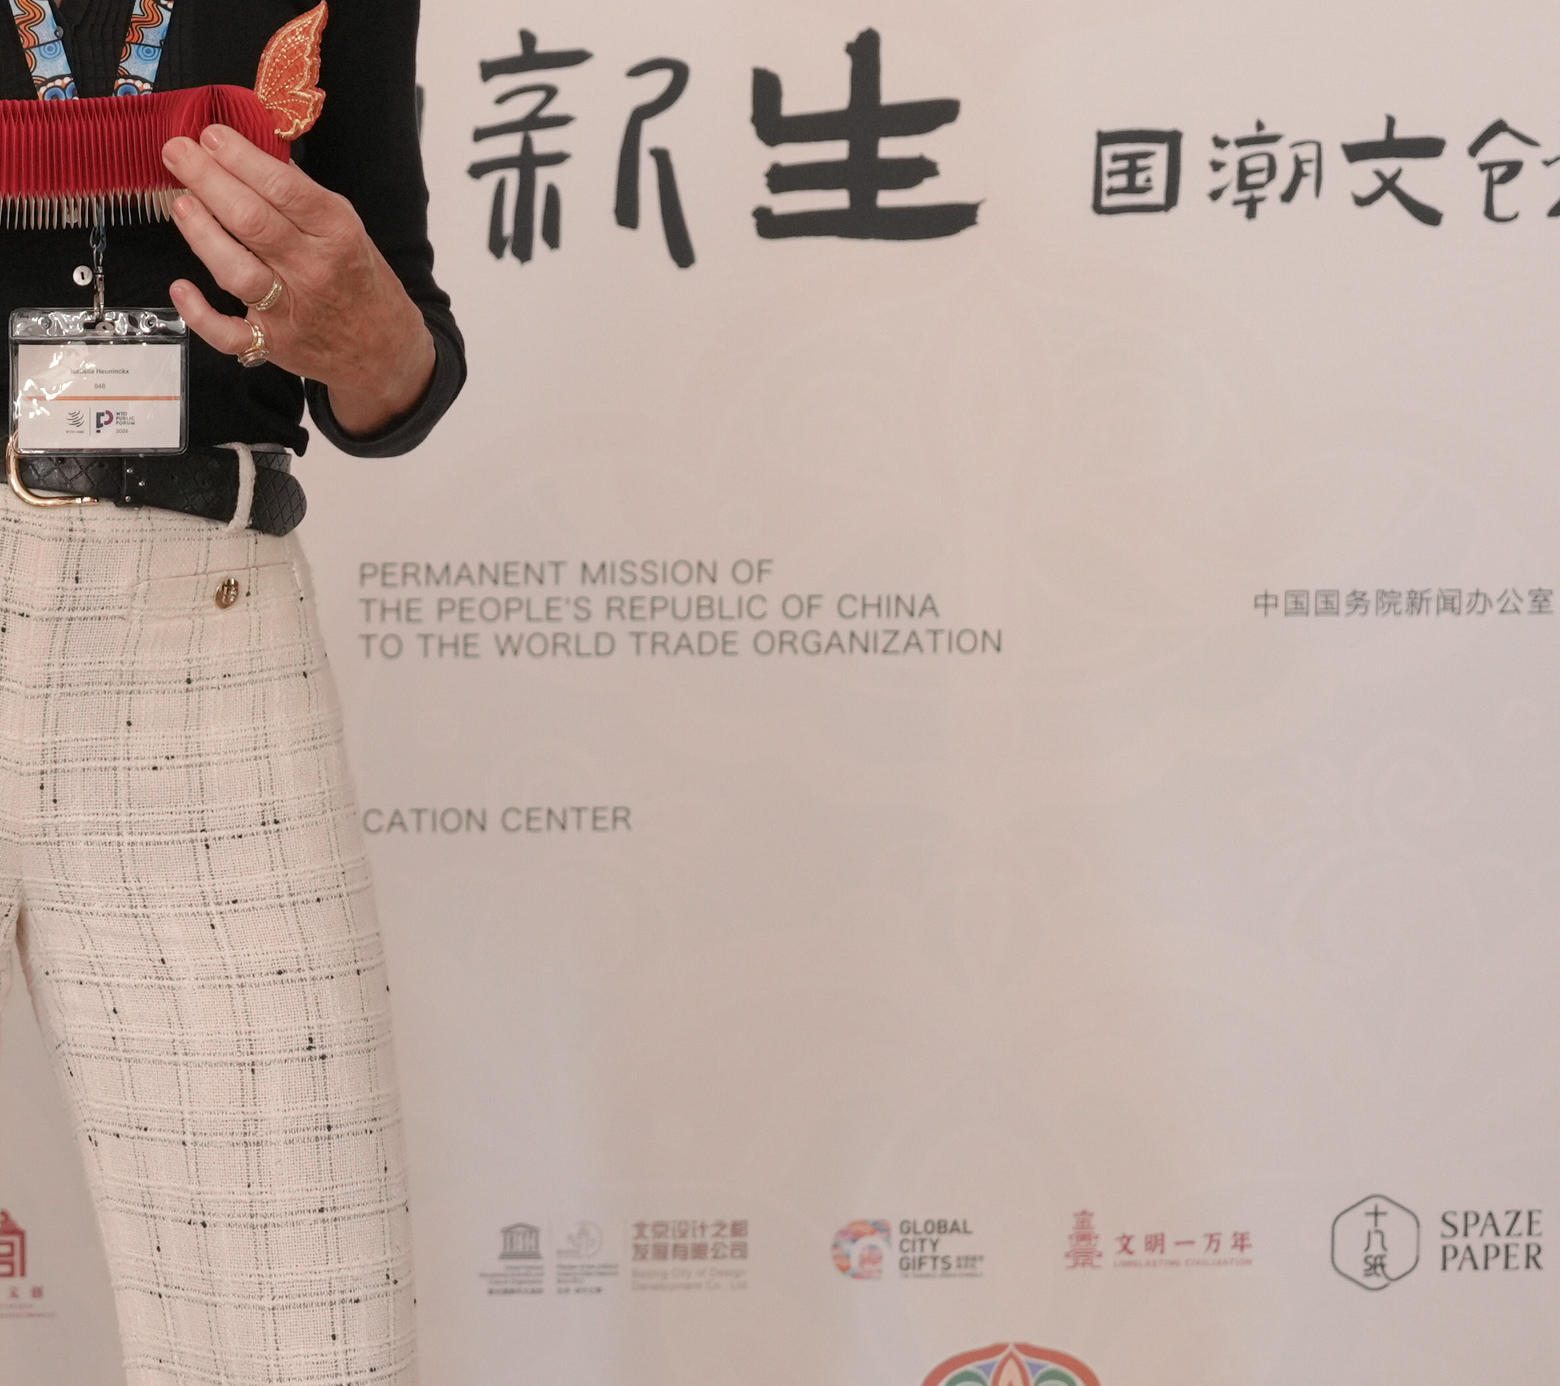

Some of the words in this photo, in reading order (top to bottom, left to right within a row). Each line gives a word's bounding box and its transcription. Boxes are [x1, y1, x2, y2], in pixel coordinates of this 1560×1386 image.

[416, 27, 987, 269] 新生
[359, 561, 567, 588] PERMANENT
[581, 559, 717, 586] MISSION
[731, 558, 773, 585] OF
[359, 597, 423, 624] THE
[436, 595, 593, 623] PEOPLE'S
[606, 594, 767, 622] REPUBLIC
[781, 594, 823, 621] OF
[837, 593, 940, 620] CHINA
[1253, 587, 1554, 619] 中国国务院新闻办公室
[359, 633, 403, 660] TO
[417, 633, 480, 659] THE
[493, 631, 617, 659] WORLD
[629, 630, 739, 657] TRADE
[752, 628, 1003, 656] ORGANIZATION
[361, 807, 488, 835] CATION
[501, 806, 632, 833] CENTER
[898, 1219, 973, 1237] GLOBAL
[1440, 1209, 1543, 1239] SPAZE
[898, 1238, 940, 1254] CITY
[1114, 1230, 1253, 1256] 文明一万年
[1440, 1242, 1545, 1272] PAPER
[898, 1254, 953, 1272] GIFTS
